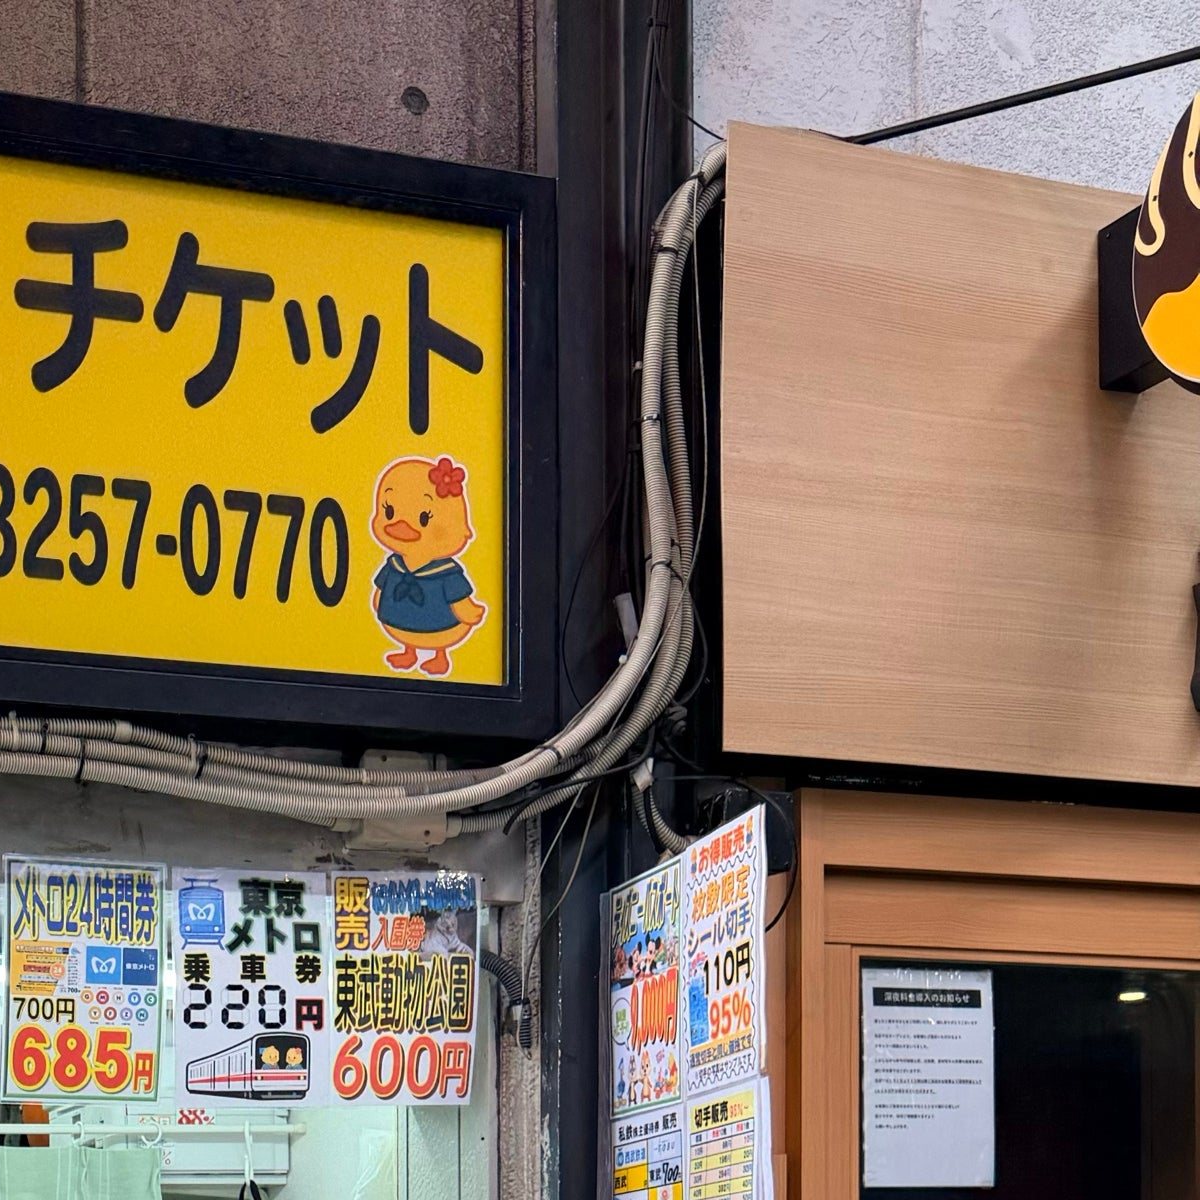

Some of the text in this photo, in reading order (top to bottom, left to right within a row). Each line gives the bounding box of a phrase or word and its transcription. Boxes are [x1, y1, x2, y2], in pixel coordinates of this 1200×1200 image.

[698, 824, 745, 873] お得販売
[13, 866, 158, 945] メトロ24時間券
[239, 878, 306, 918] 東京
[334, 876, 370, 951] 販売
[691, 866, 751, 923] 枚数限定
[225, 918, 322, 954] メトロ
[372, 916, 426, 951] 入園券
[688, 902, 751, 959] シール切手
[183, 953, 322, 985] 乗車券
[334, 952, 475, 1035] 東武動物公園
[702, 940, 751, 995] 110円
[13, 998, 75, 1023] 700円
[183, 983, 324, 1032] 220円
[708, 987, 751, 1040] 95%
[10, 1024, 154, 1094] 685円
[332, 1034, 471, 1100] 600円
[694, 1100, 728, 1129] 切手販売
